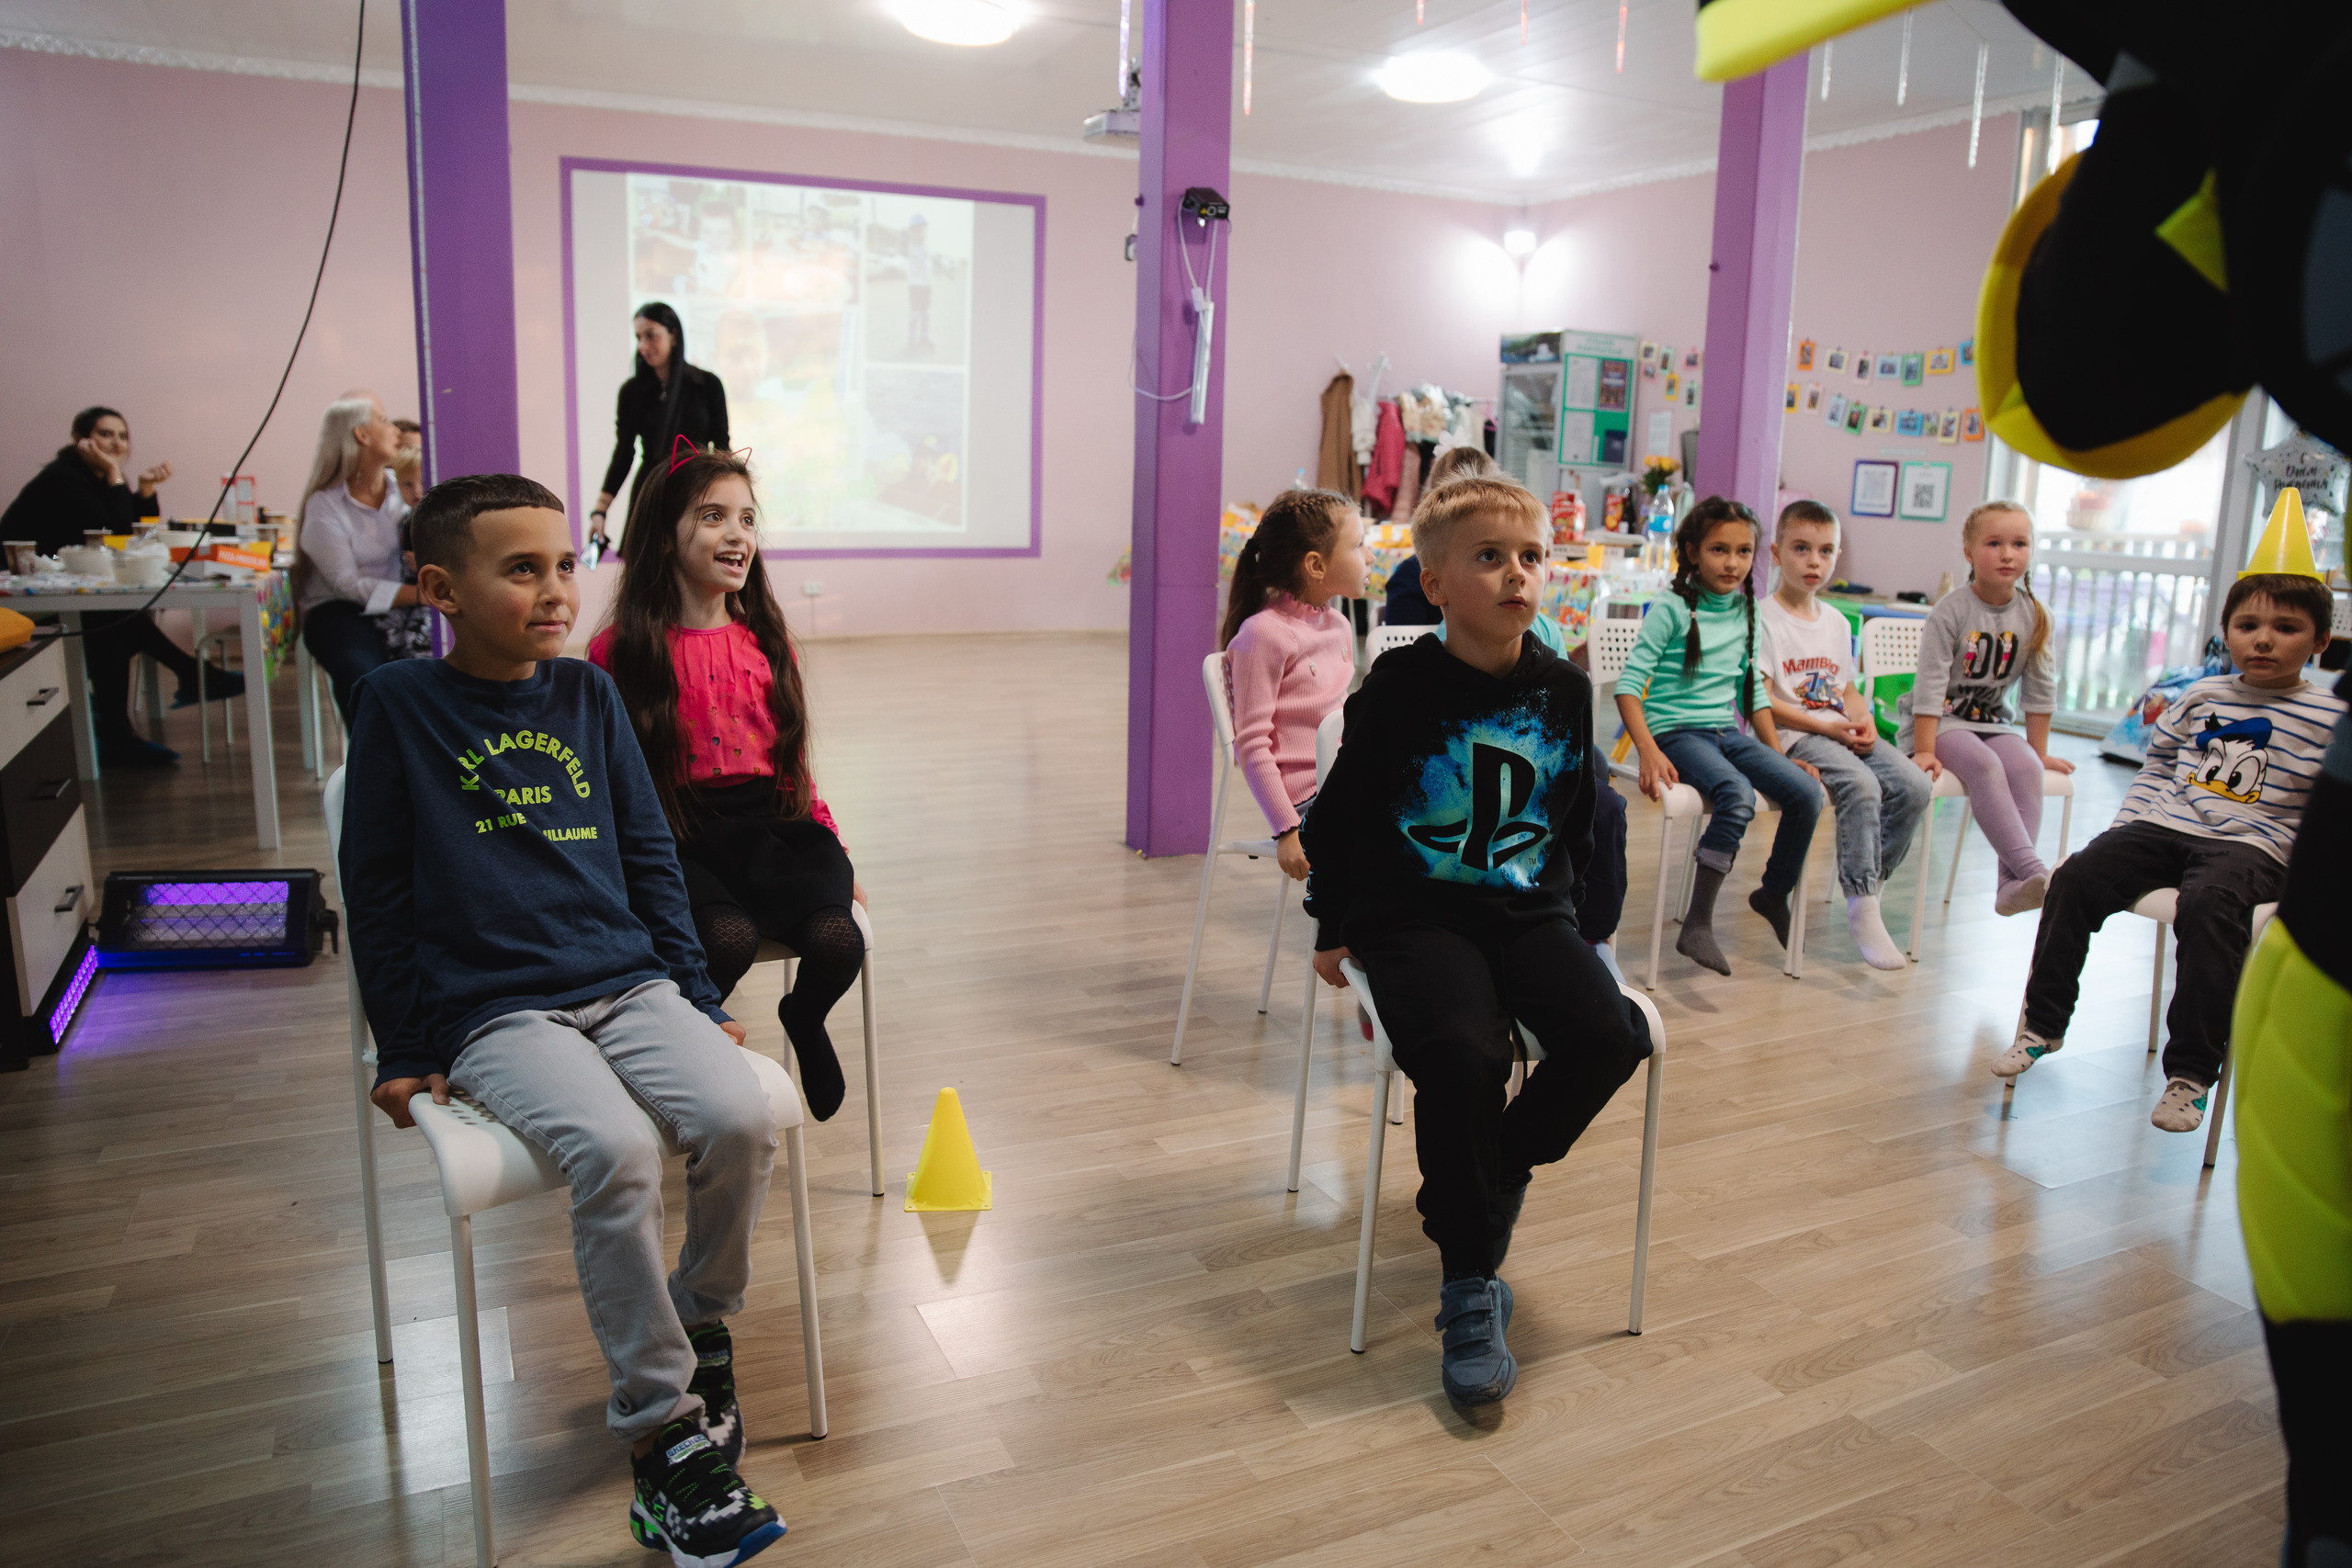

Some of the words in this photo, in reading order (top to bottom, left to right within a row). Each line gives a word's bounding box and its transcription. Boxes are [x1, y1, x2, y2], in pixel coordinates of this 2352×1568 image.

[1805, 671, 1819, 693] 7
[458, 748, 485, 791] KRL
[483, 729, 591, 798] LAGERFELD
[475, 818, 493, 834] 21
[497, 812, 527, 829] RUE
